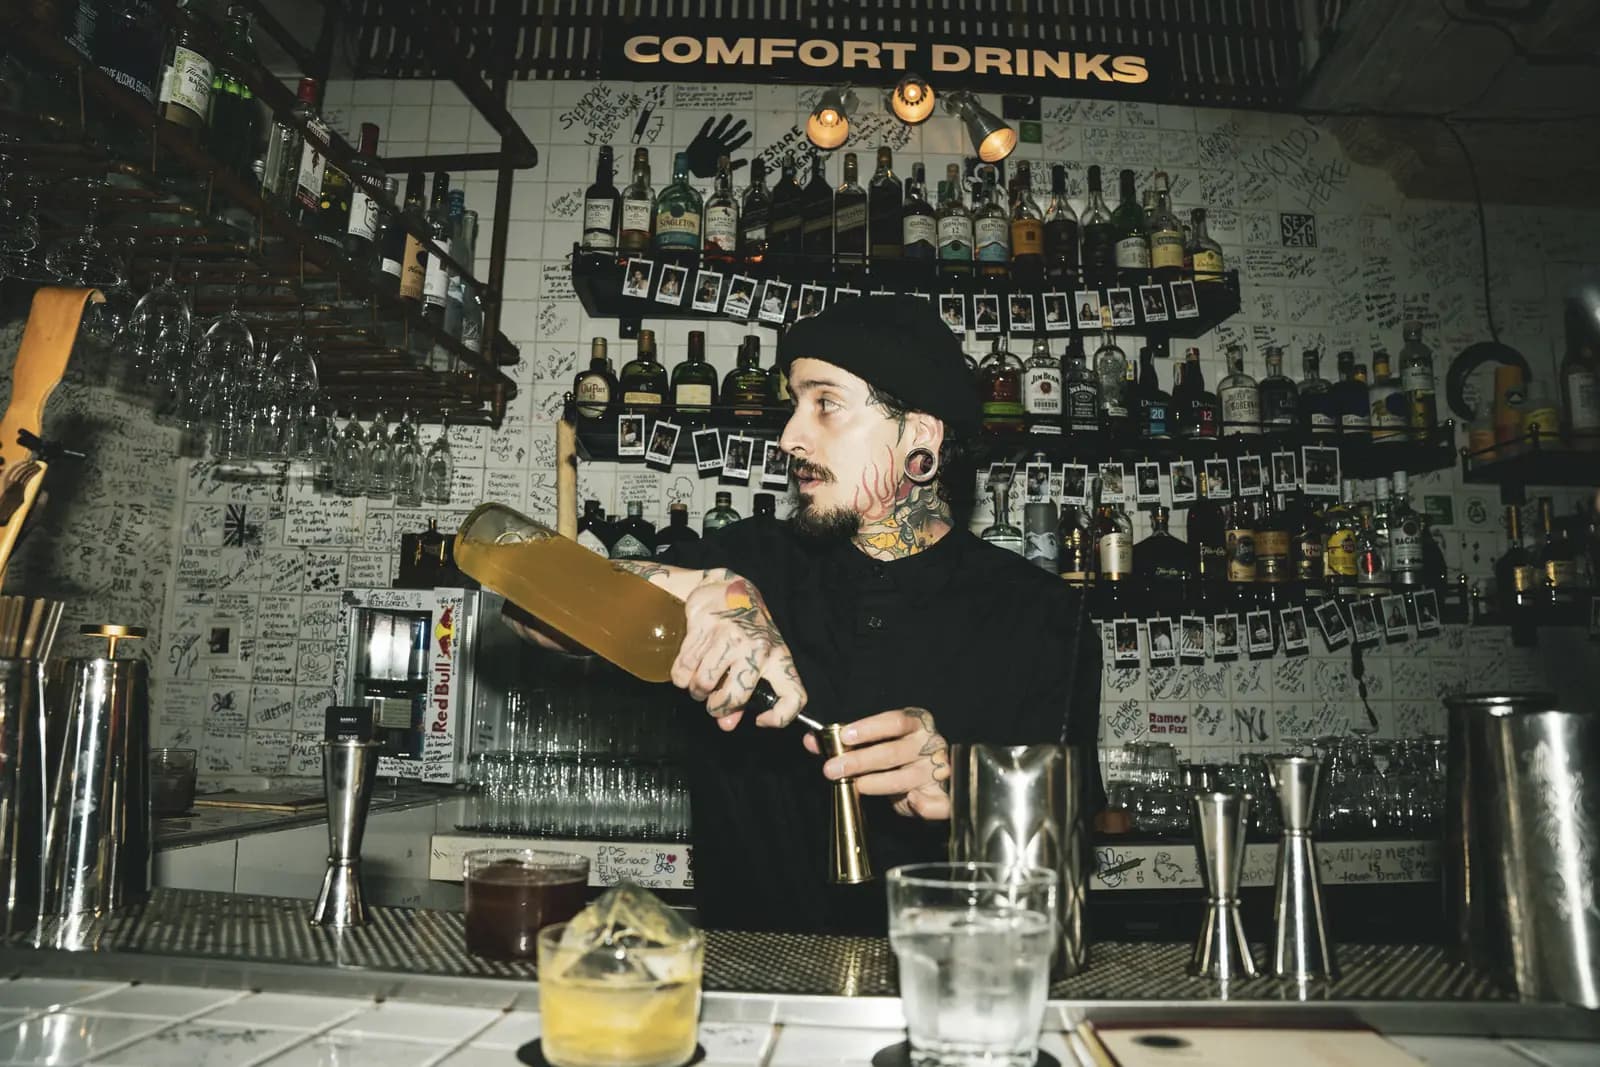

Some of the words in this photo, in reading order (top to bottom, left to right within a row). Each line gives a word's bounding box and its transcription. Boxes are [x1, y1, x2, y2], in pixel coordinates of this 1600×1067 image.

[623, 35, 917, 70] COMFORT
[931, 44, 1150, 85] DRINKS
[1031, 374, 1043, 385] JIM
[1043, 371, 1060, 384] BEAM
[1151, 409, 1165, 420] 20
[1202, 410, 1213, 421] 12
[1395, 537, 1419, 545] BACAR
[434, 662, 451, 696] Bull
[432, 699, 449, 733] Red
[1149, 712, 1187, 723] Ramos
[1150, 724, 1167, 734] Gin
[1168, 724, 1188, 734] Fizz
